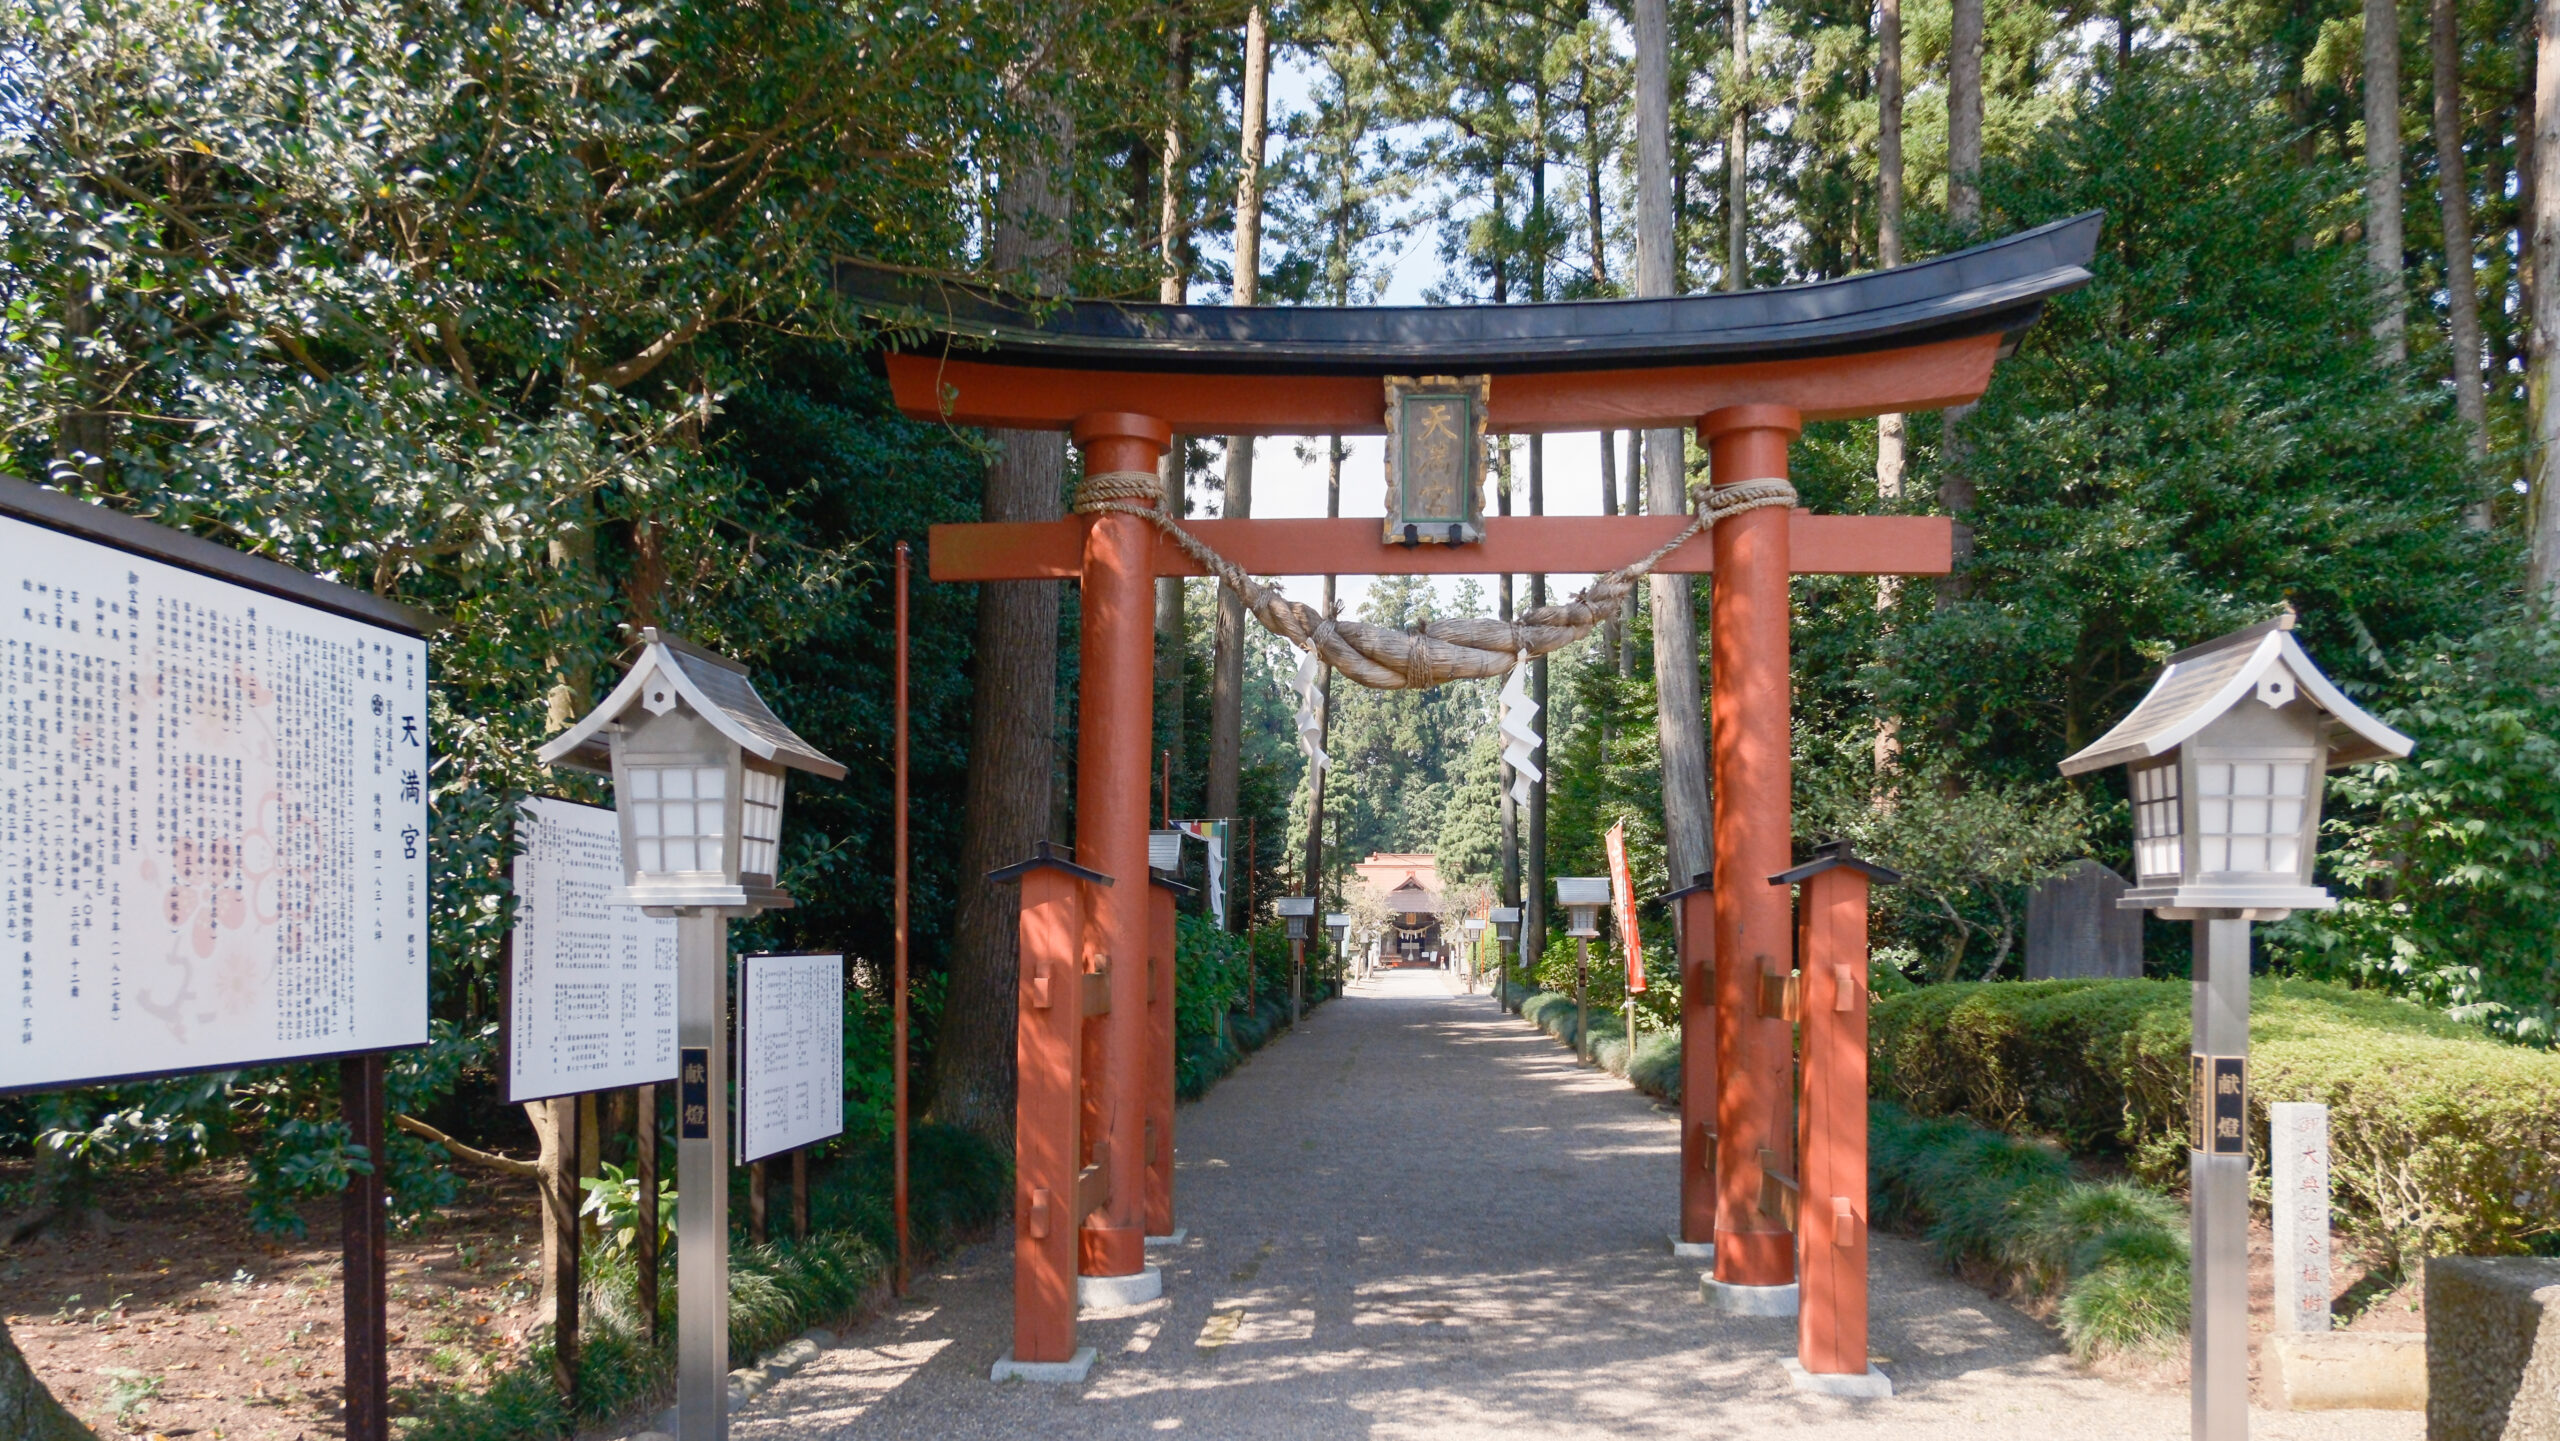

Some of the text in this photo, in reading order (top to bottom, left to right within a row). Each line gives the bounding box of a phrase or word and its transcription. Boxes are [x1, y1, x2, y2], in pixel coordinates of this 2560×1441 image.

[1417, 404, 1458, 517] 天満宮
[400, 715, 421, 860] 天満宮
[684, 1063, 706, 1125] 献燈
[2217, 1073, 2241, 1138] 献燈
